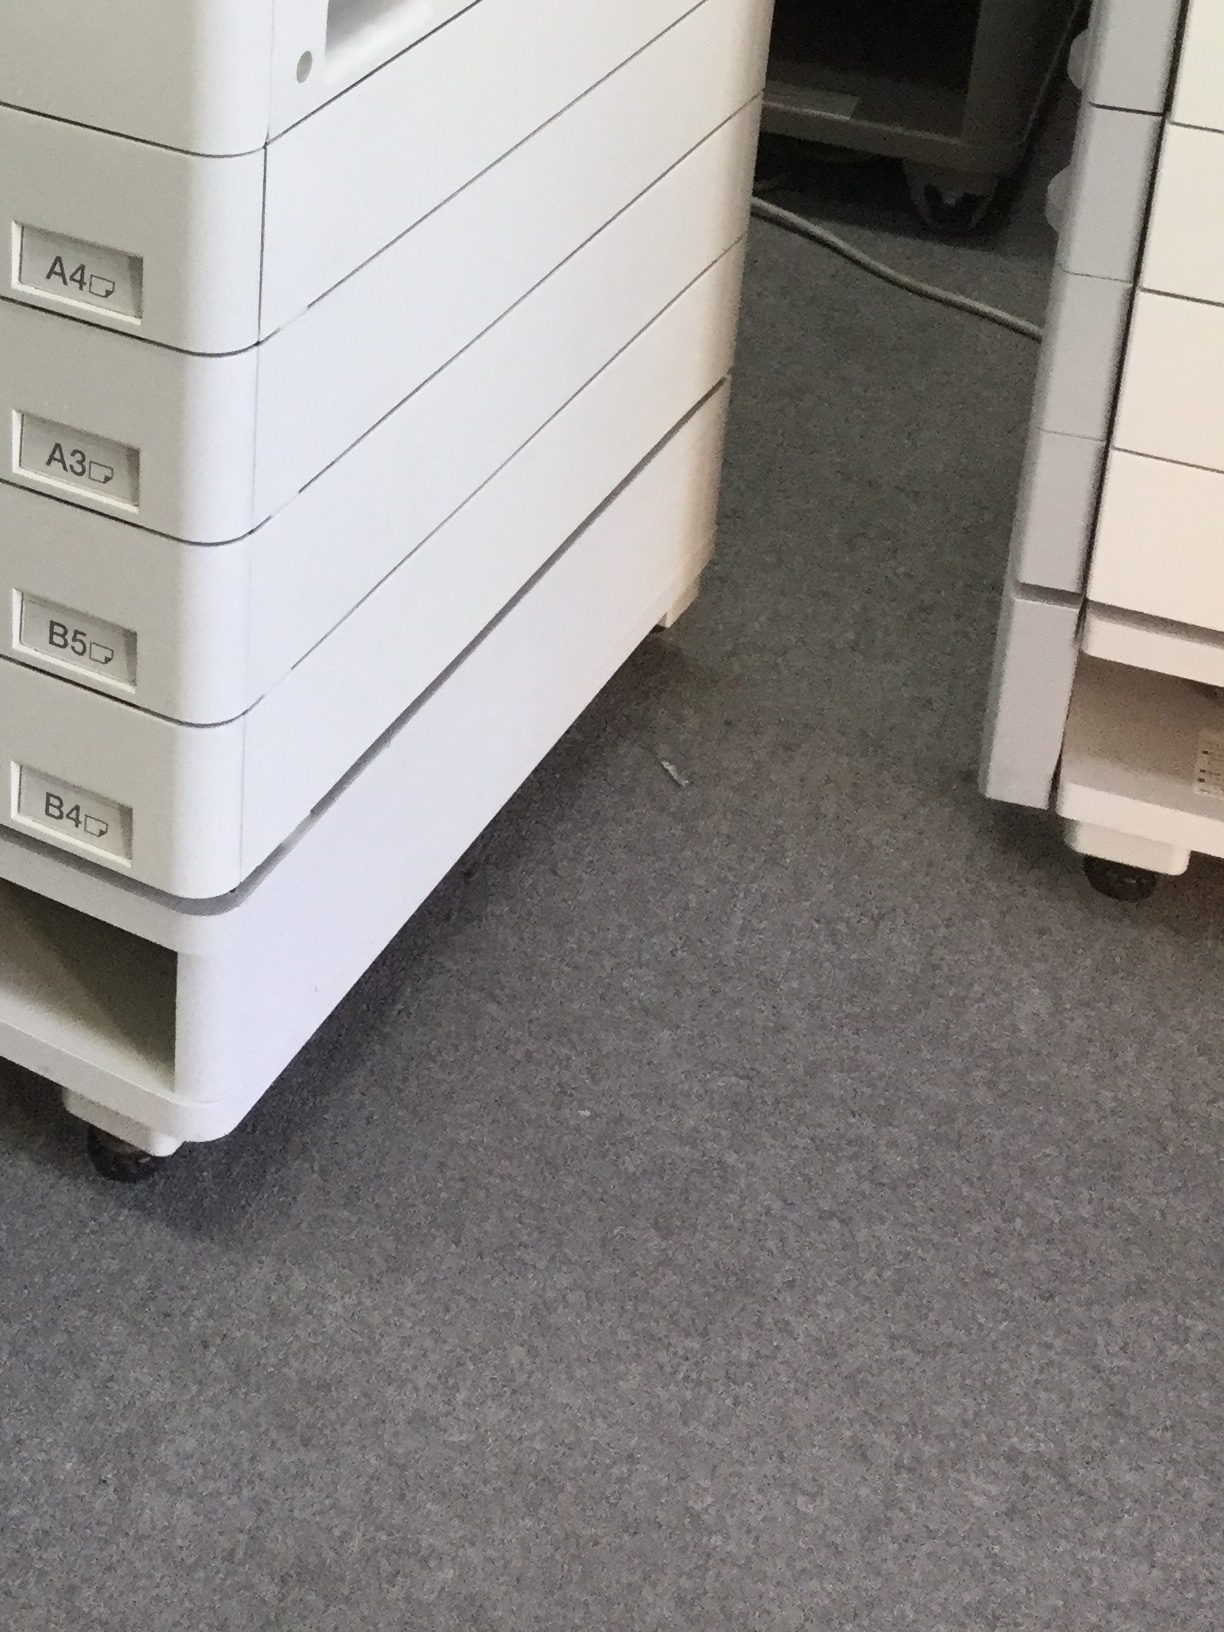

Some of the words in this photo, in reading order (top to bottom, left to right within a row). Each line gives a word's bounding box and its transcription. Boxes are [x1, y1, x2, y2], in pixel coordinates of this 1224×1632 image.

[45, 255, 87, 291] A4
[45, 442, 87, 477] A3
[48, 619, 88, 657] B5
[44, 791, 82, 829] B4
